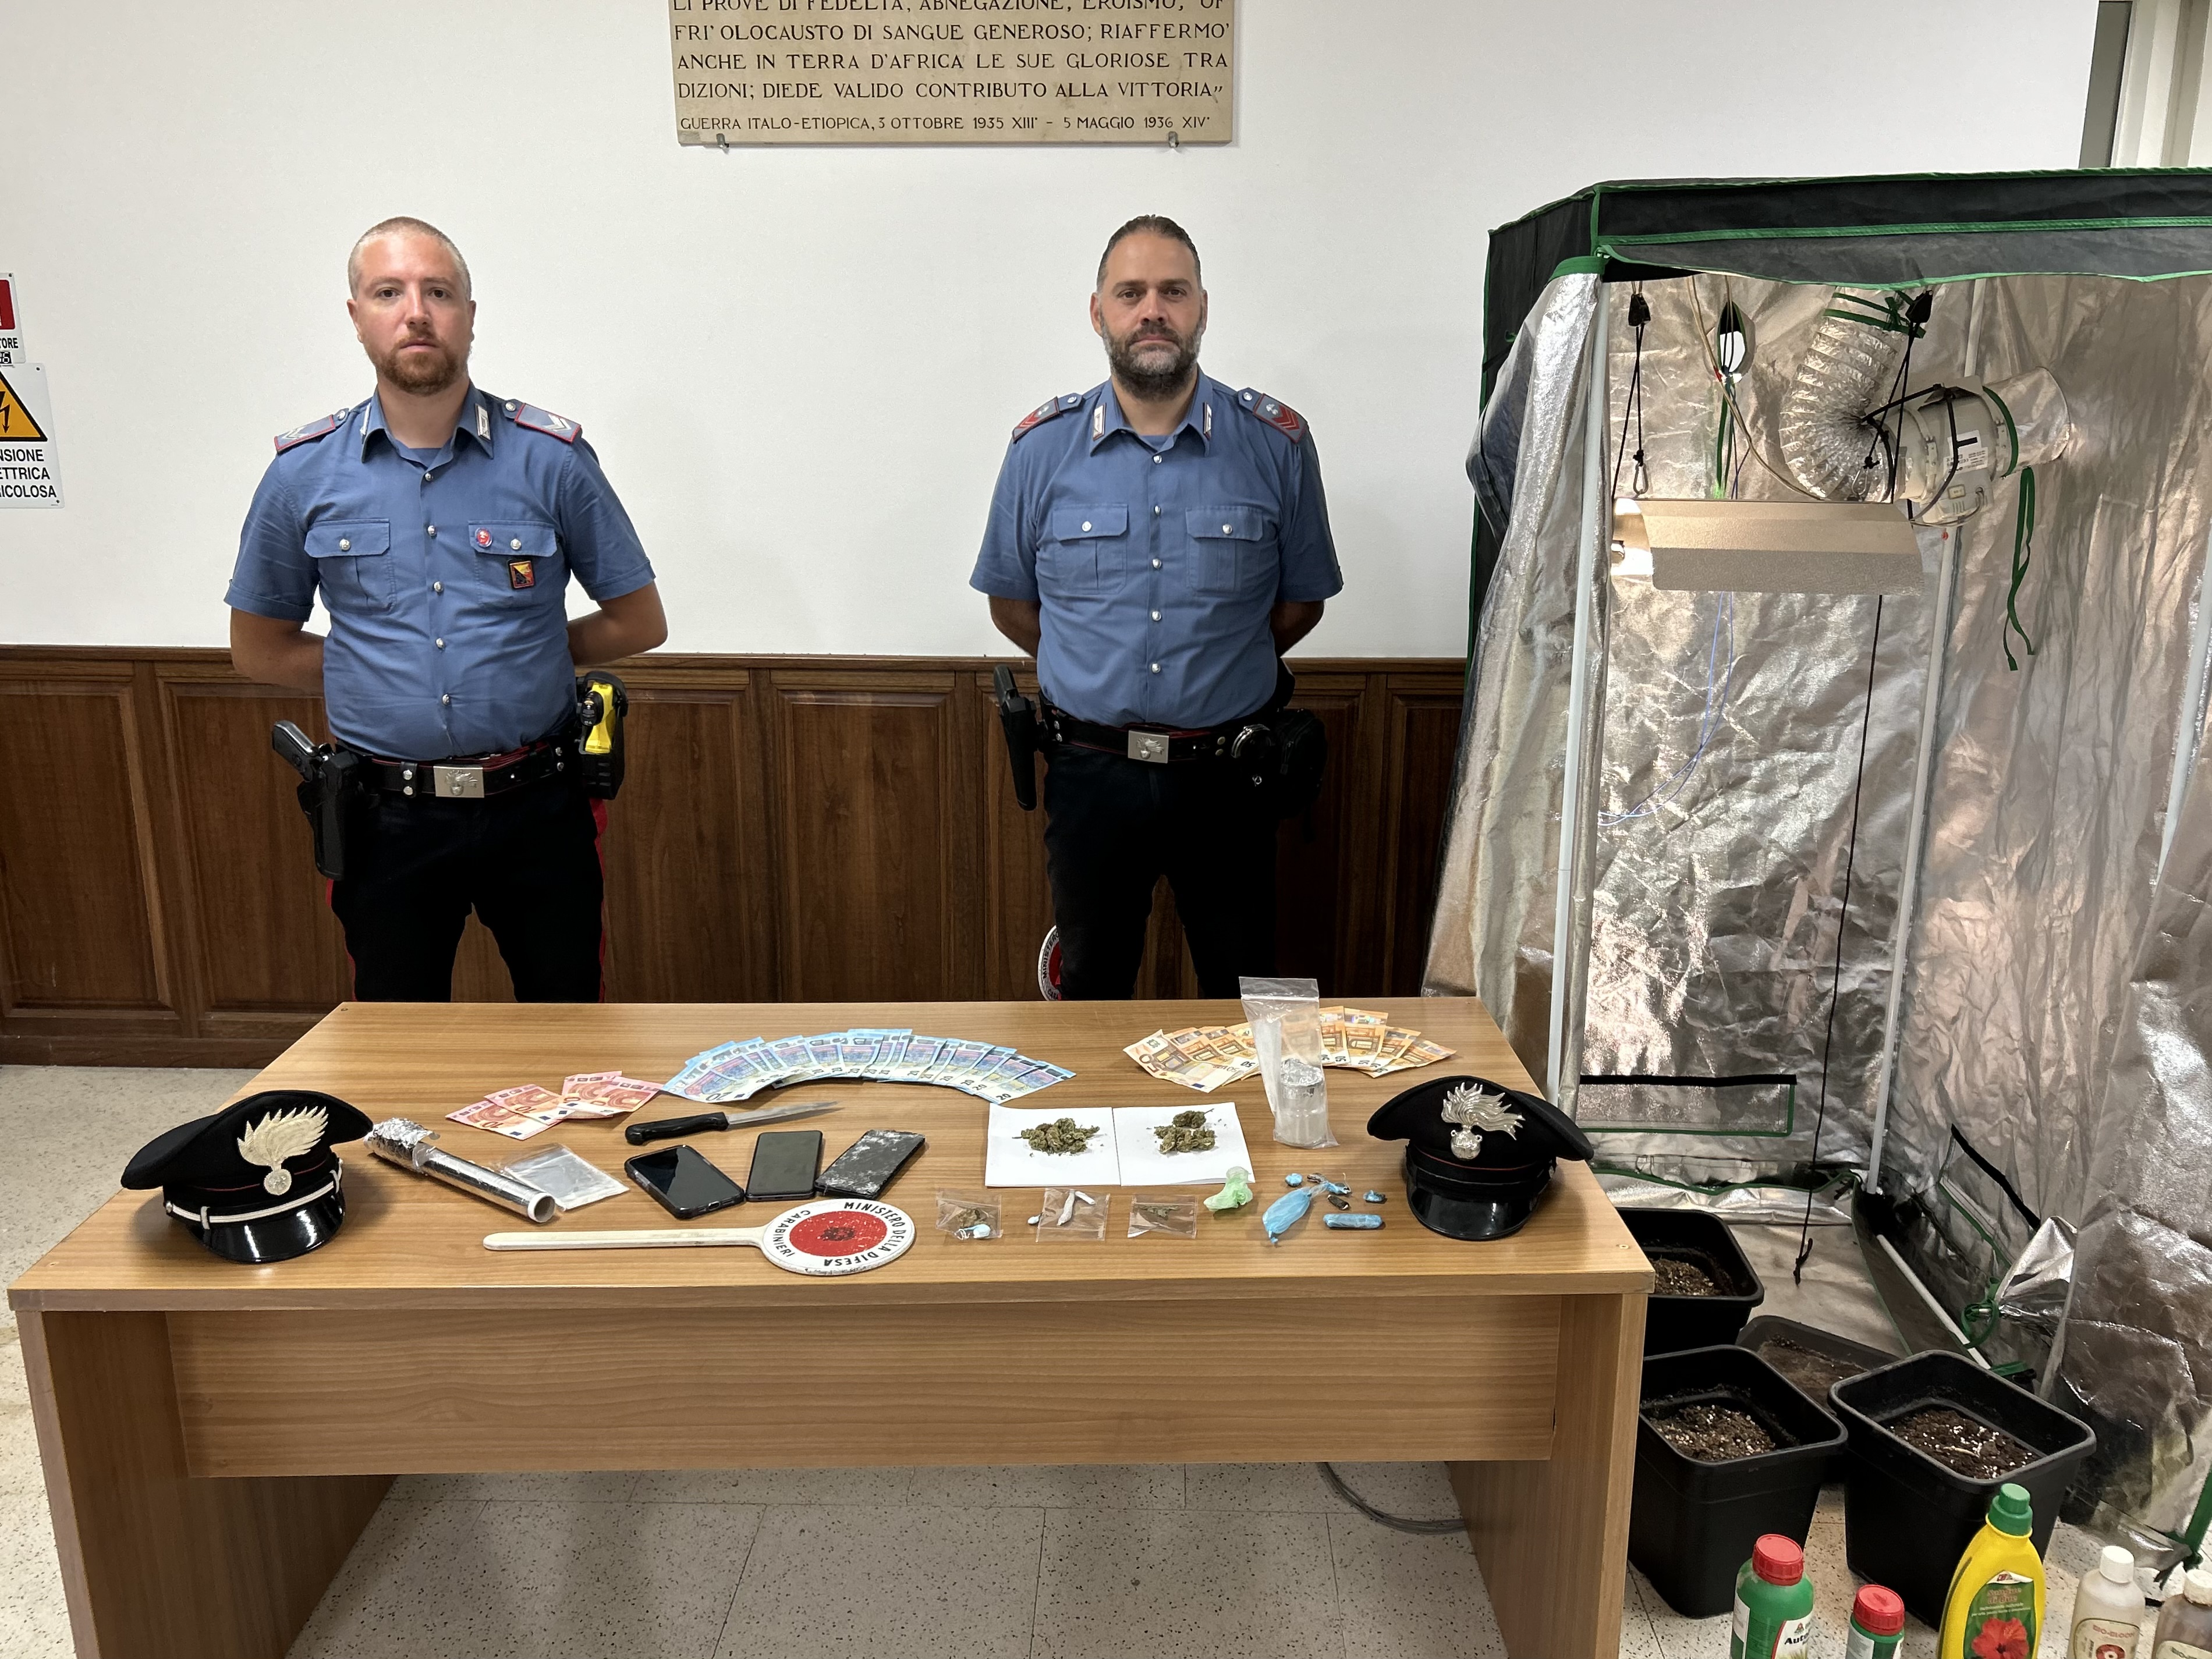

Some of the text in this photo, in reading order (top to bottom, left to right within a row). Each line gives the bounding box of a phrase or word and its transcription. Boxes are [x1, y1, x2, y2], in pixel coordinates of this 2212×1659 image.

[721, 24, 843, 40] OLOCAUSTO
[854, 24, 872, 40] DI
[883, 24, 964, 41] SANGUE
[974, 24, 1091, 42] GENEROSO;
[678, 52, 1228, 69] ANCHE IN TERRA D'AFRICA LE SUE GLORIOSE TRA
[678, 83, 754, 100] DIZIONI;
[763, 83, 823, 98] DIEDE
[834, 83, 903, 98] VALIDO
[916, 83, 1047, 98] CONTRIBUTO
[1055, 82, 1108, 98] ALLA
[680, 118, 742, 130] GUERRA
[878, 117, 885, 129] 3
[891, 117, 965, 130] OTTOBRE
[973, 117, 1004, 129] 1935
[1064, 117, 1071, 129] 5
[1077, 116, 1135, 129] MAGGIO
[1143, 117, 1174, 129] 1936
[772, 1210, 811, 1257] CARABINIERI
[824, 1201, 907, 1267] MINISTERO DELLA DIFESA
